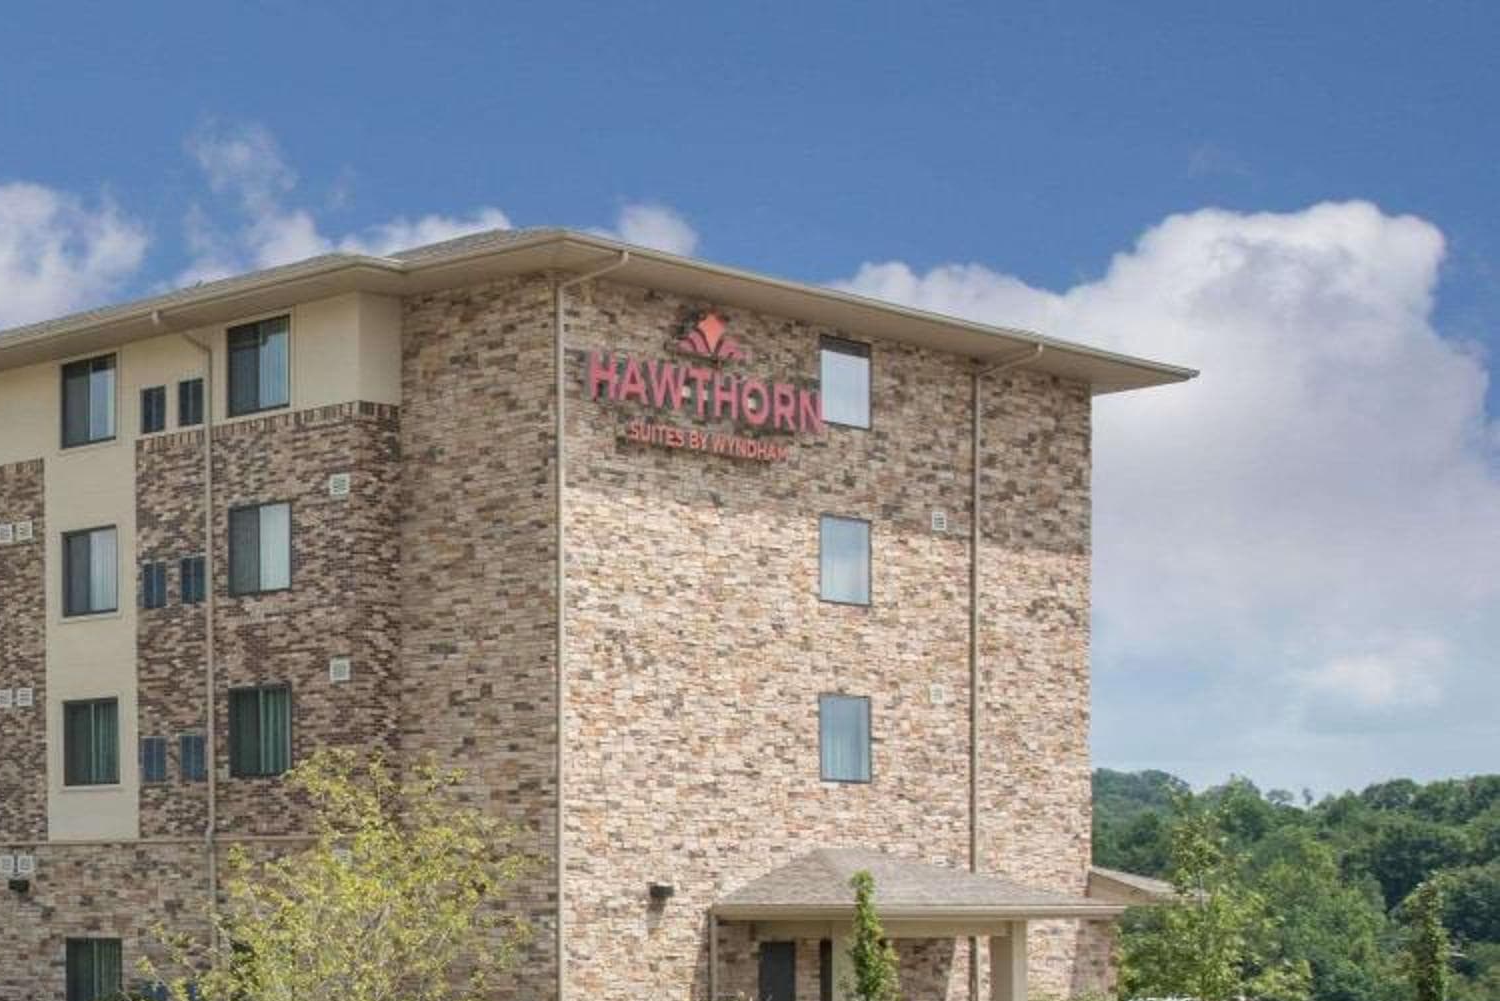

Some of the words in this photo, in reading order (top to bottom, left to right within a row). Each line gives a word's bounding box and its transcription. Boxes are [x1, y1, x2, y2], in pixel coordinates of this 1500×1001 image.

[589, 352, 824, 432] HAWTHORN
[628, 421, 684, 448] SUITES
[689, 431, 708, 449] BY
[712, 433, 790, 461] WYNDHAM
